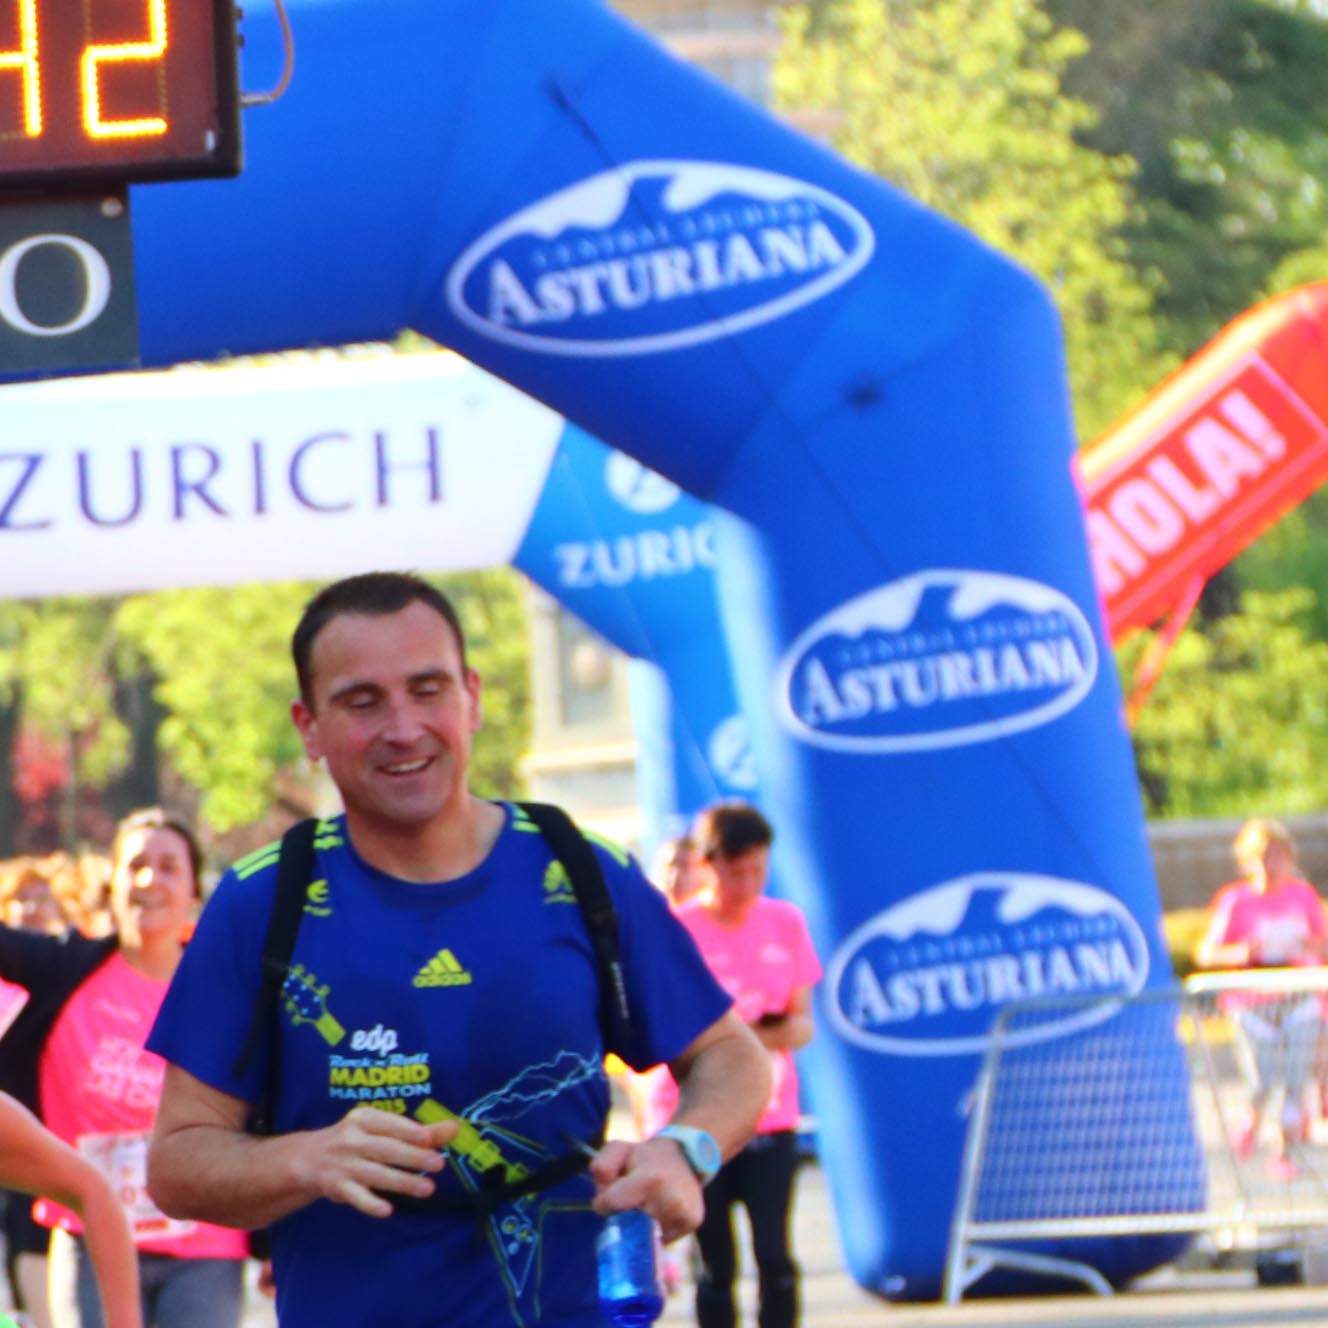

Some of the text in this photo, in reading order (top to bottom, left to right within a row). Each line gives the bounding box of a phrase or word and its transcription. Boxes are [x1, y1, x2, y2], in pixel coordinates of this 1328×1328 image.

[487, 220, 846, 327] ASTURIANA
[802, 635, 1087, 728] ASTURIANA
[850, 936, 1136, 1030] ASTURIANA
[330, 1063, 431, 1087] MADRID
[350, 1023, 399, 1058] edp
